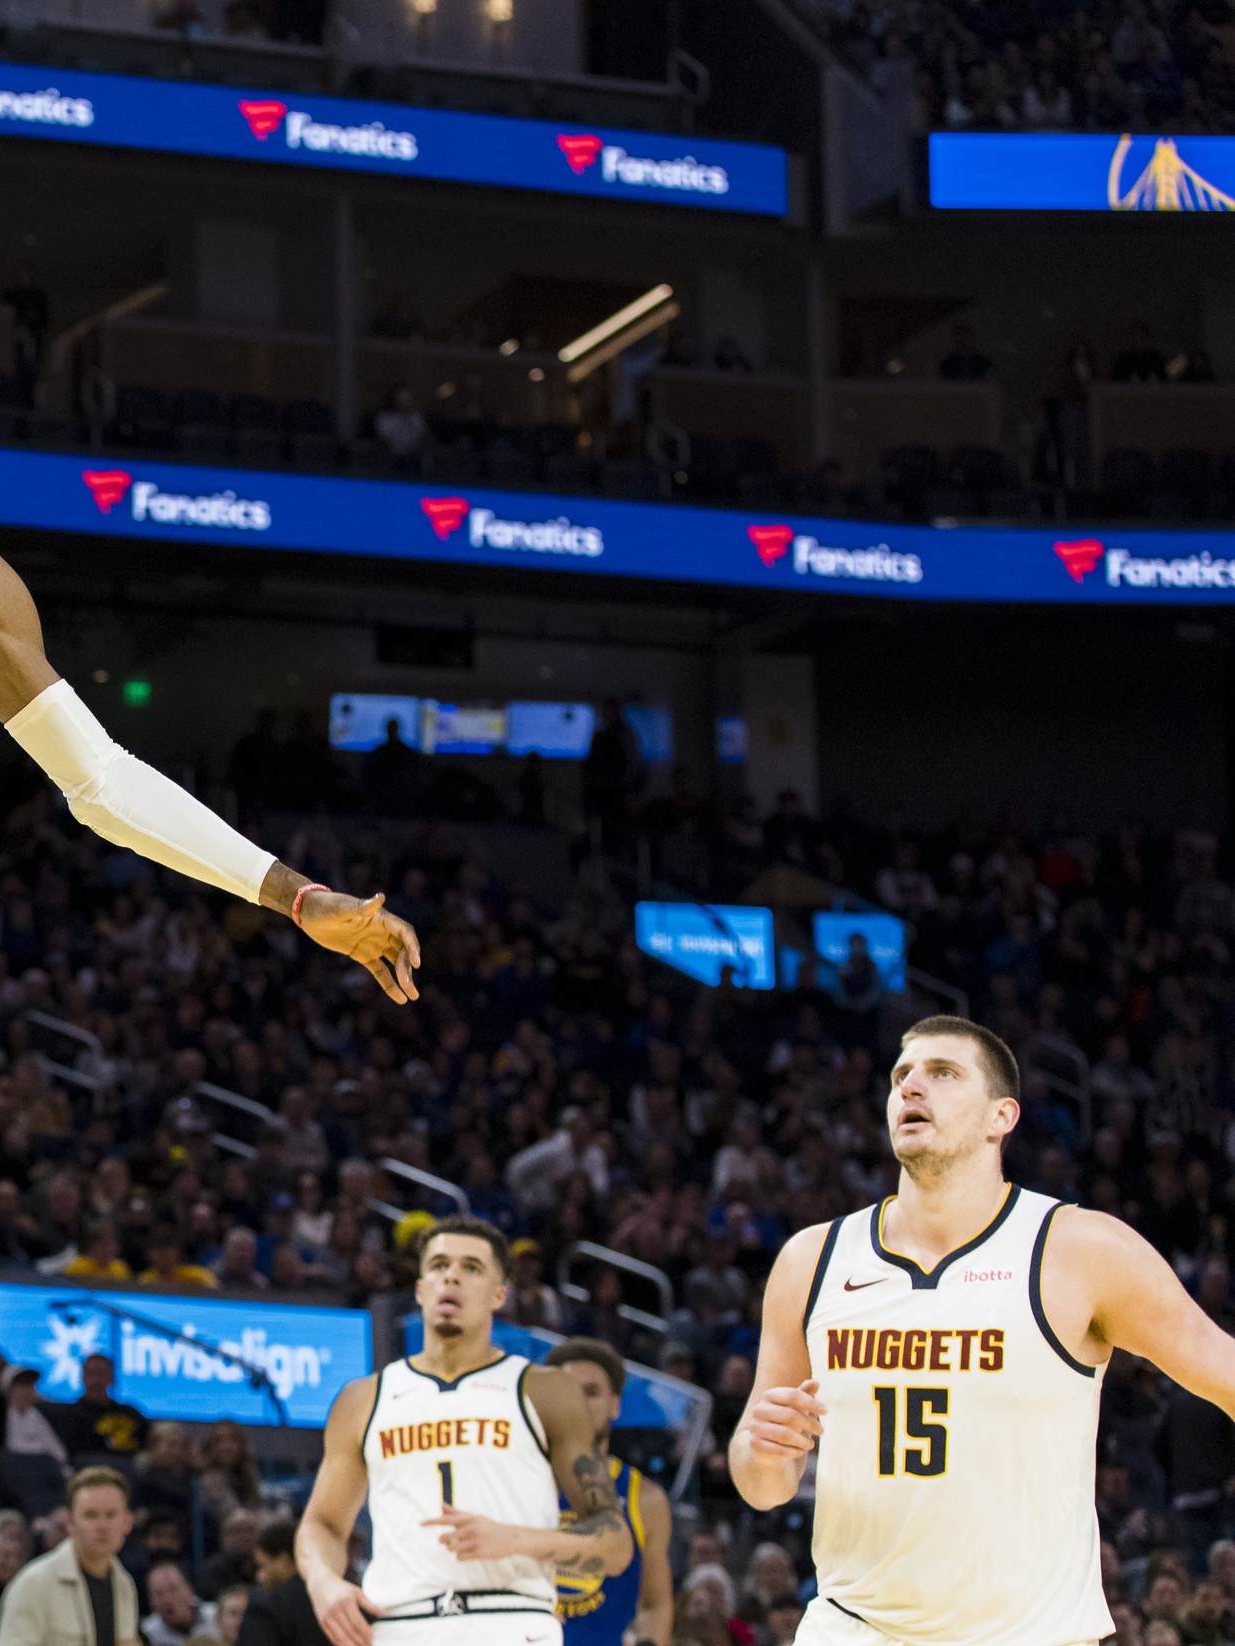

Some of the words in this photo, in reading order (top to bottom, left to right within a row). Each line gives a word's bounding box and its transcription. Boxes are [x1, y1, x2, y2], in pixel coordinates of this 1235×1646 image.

[286, 110, 418, 160] Fanatics
[602, 145, 729, 194] Fanatics
[132, 481, 271, 530] Fanatics
[469, 508, 603, 556] Fanatics
[793, 536, 923, 583] Fanatics
[964, 1270, 1013, 1283] ibotta
[827, 1328, 1005, 1373] NUGGETS
[378, 1418, 512, 1460] NUGGETS
[872, 1385, 951, 1479] 15
[436, 1460, 455, 1508] 1
